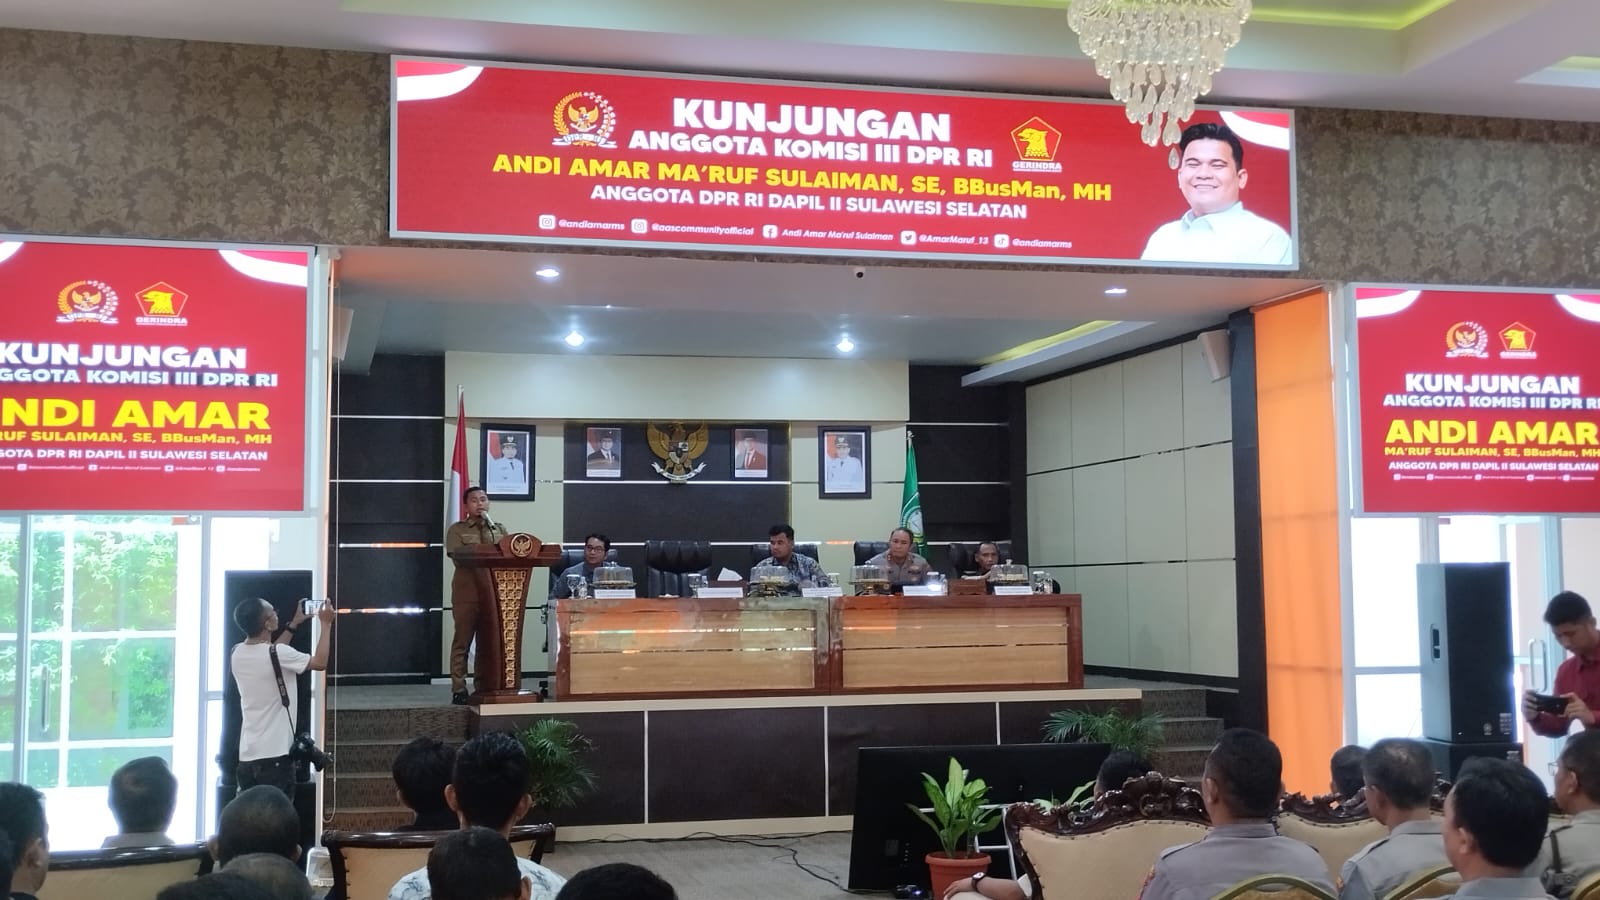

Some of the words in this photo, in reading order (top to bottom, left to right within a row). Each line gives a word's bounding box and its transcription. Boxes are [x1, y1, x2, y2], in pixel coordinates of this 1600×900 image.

[674, 98, 950, 142] KUNJUNGAN
[629, 130, 768, 156] ANGGOTA
[774, 138, 868, 161] KOMISI
[875, 144, 900, 163] III
[907, 146, 960, 166] DPR
[967, 148, 992, 167] RI
[1012, 161, 1062, 169] GERINDRA
[493, 154, 560, 174] ANDI
[569, 158, 650, 179] AMAR
[766, 169, 904, 194] SULAIMAN,
[912, 176, 946, 195] SE,
[954, 178, 1066, 201] BBusMan,
[1074, 183, 1111, 201] MH
[591, 185, 694, 204] ANGGOTA
[699, 190, 739, 206] DPR
[745, 193, 763, 207] RI
[769, 194, 825, 210] DAPIL
[830, 197, 841, 211] II
[846, 197, 941, 215] SULAWESI
[946, 202, 1027, 218] SELATAN
[559, 220, 624, 230] @andiamarms
[782, 228, 802, 237] Andi
[803, 229, 827, 238] Amar
[855, 231, 893, 241] Sulaiman
[1012, 239, 1072, 248] @andiamarms
[0, 342, 246, 368] KUNJUNGAN
[87, 370, 169, 384] KOMISI
[175, 372, 197, 385] III
[203, 372, 249, 386] DPR
[256, 374, 277, 386] RI
[1406, 374, 1579, 394] KUNJUNGAN
[1384, 395, 1465, 406] ANGGOTA
[1469, 396, 1526, 407] KOMISI
[1530, 397, 1545, 408] III
[1550, 397, 1582, 408] DPR
[2, 398, 95, 427] NDI
[112, 400, 270, 429] AMAR
[32, 431, 127, 442] SULAIMAN,
[133, 433, 156, 443] SE,
[162, 433, 239, 444] BBusMan,
[245, 434, 272, 444] MH
[1386, 420, 1477, 445] ANDI
[1489, 421, 1599, 445] AMAR
[37, 449, 65, 457] DPR
[69, 450, 82, 458] RI
[86, 450, 125, 458] DAPIL
[140, 451, 207, 459] SULAWESI
[210, 451, 267, 460] SELATAN
[1434, 447, 1500, 456] SULAIMAN,
[1504, 448, 1520, 456] SE,
[1524, 448, 1578, 457] BBusMan,
[1472, 462, 1500, 470] DAPIL
